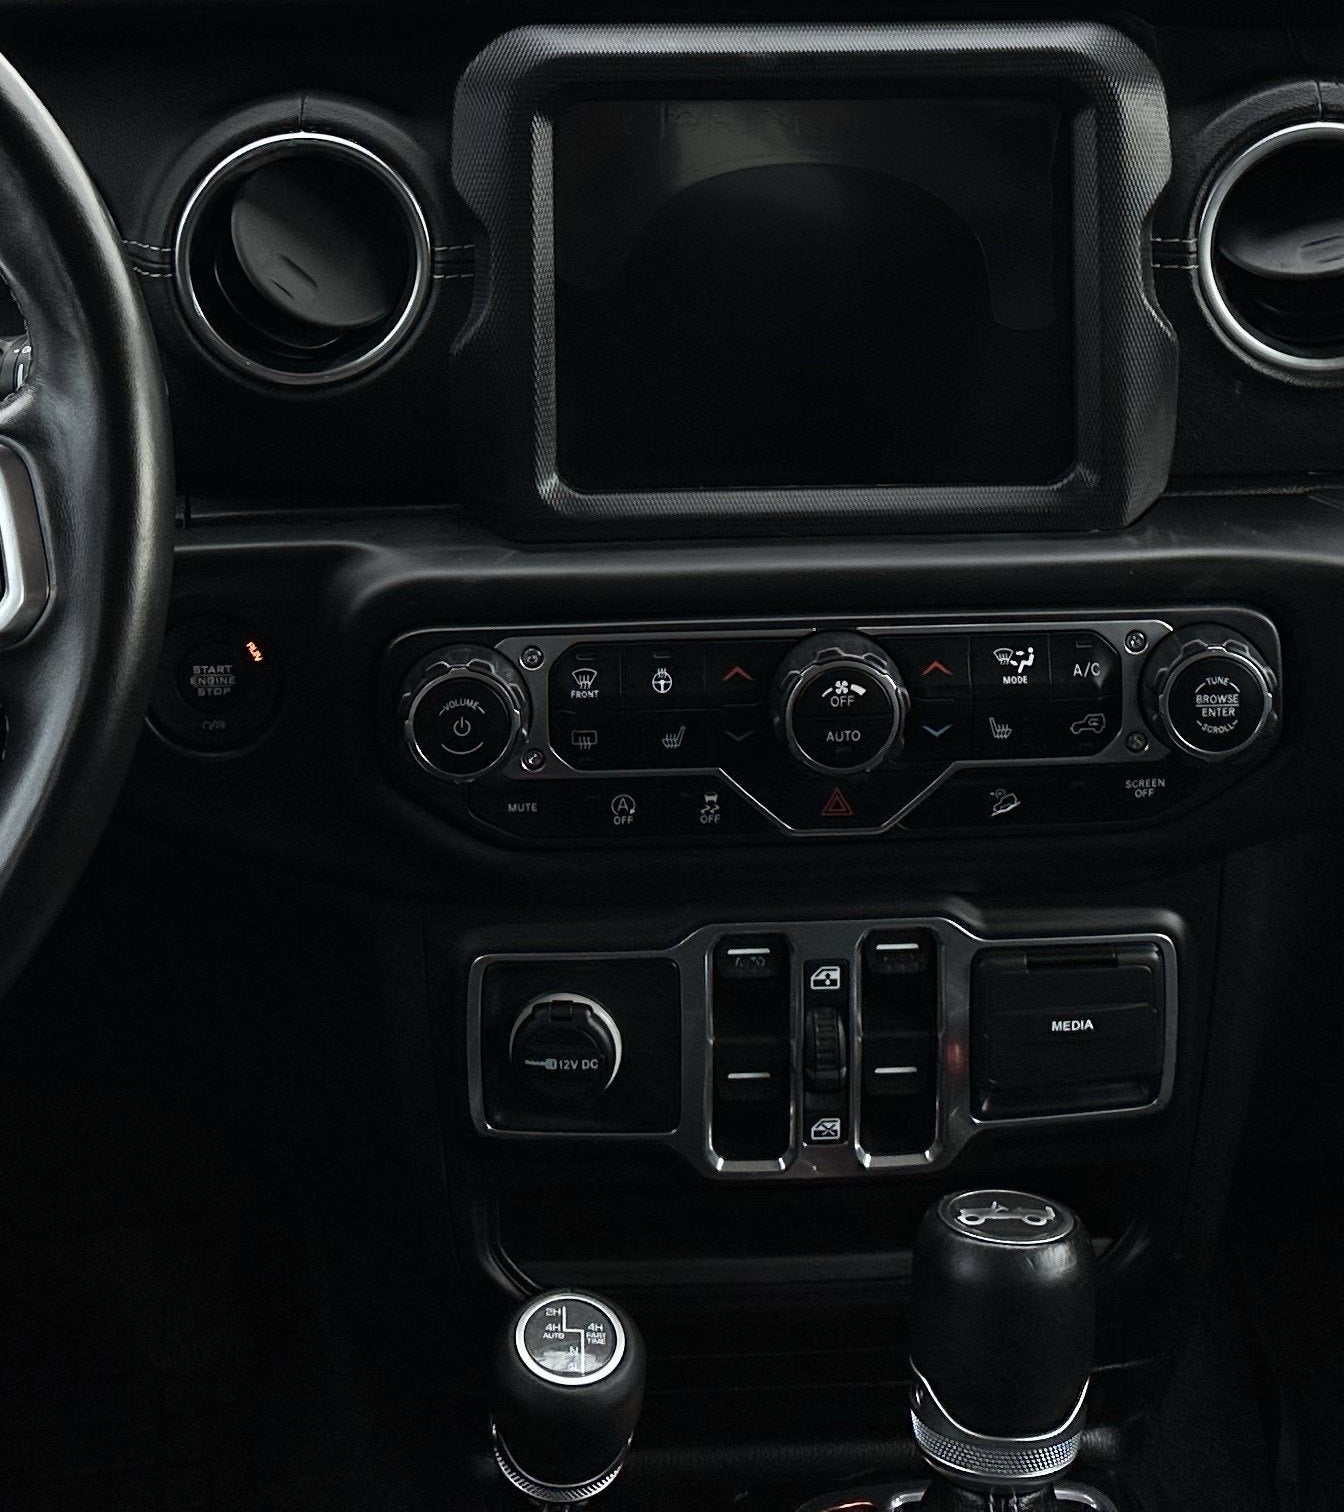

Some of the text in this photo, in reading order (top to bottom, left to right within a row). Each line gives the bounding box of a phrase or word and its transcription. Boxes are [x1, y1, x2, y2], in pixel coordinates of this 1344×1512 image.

[245, 641, 265, 663] RUN
[192, 665, 233, 675] START
[1073, 662, 1101, 678] A/C
[189, 676, 237, 686] ENGINE
[1002, 675, 1029, 685] MODE
[1206, 676, 1231, 687] TUNE
[197, 688, 232, 697] STOP
[570, 689, 599, 699] FRONT
[831, 695, 855, 708] OFF
[1196, 693, 1241, 705] BROWSE
[442, 698, 479, 712] VOLUME
[1201, 706, 1236, 718] ENTER
[1201, 721, 1236, 735] SCROLL
[826, 729, 862, 743] AUTO
[1125, 778, 1167, 789] SCREEN
[1134, 788, 1155, 799] OFF
[508, 803, 538, 813] MUTE
[613, 815, 634, 826] OFF
[699, 814, 721, 825] OFF
[1051, 1018, 1095, 1032] MEDIA
[558, 1058, 599, 1071] 12V DC
[545, 1307, 562, 1316] 2H
[545, 1323, 561, 1332] 4H
[587, 1322, 604, 1332] 4H
